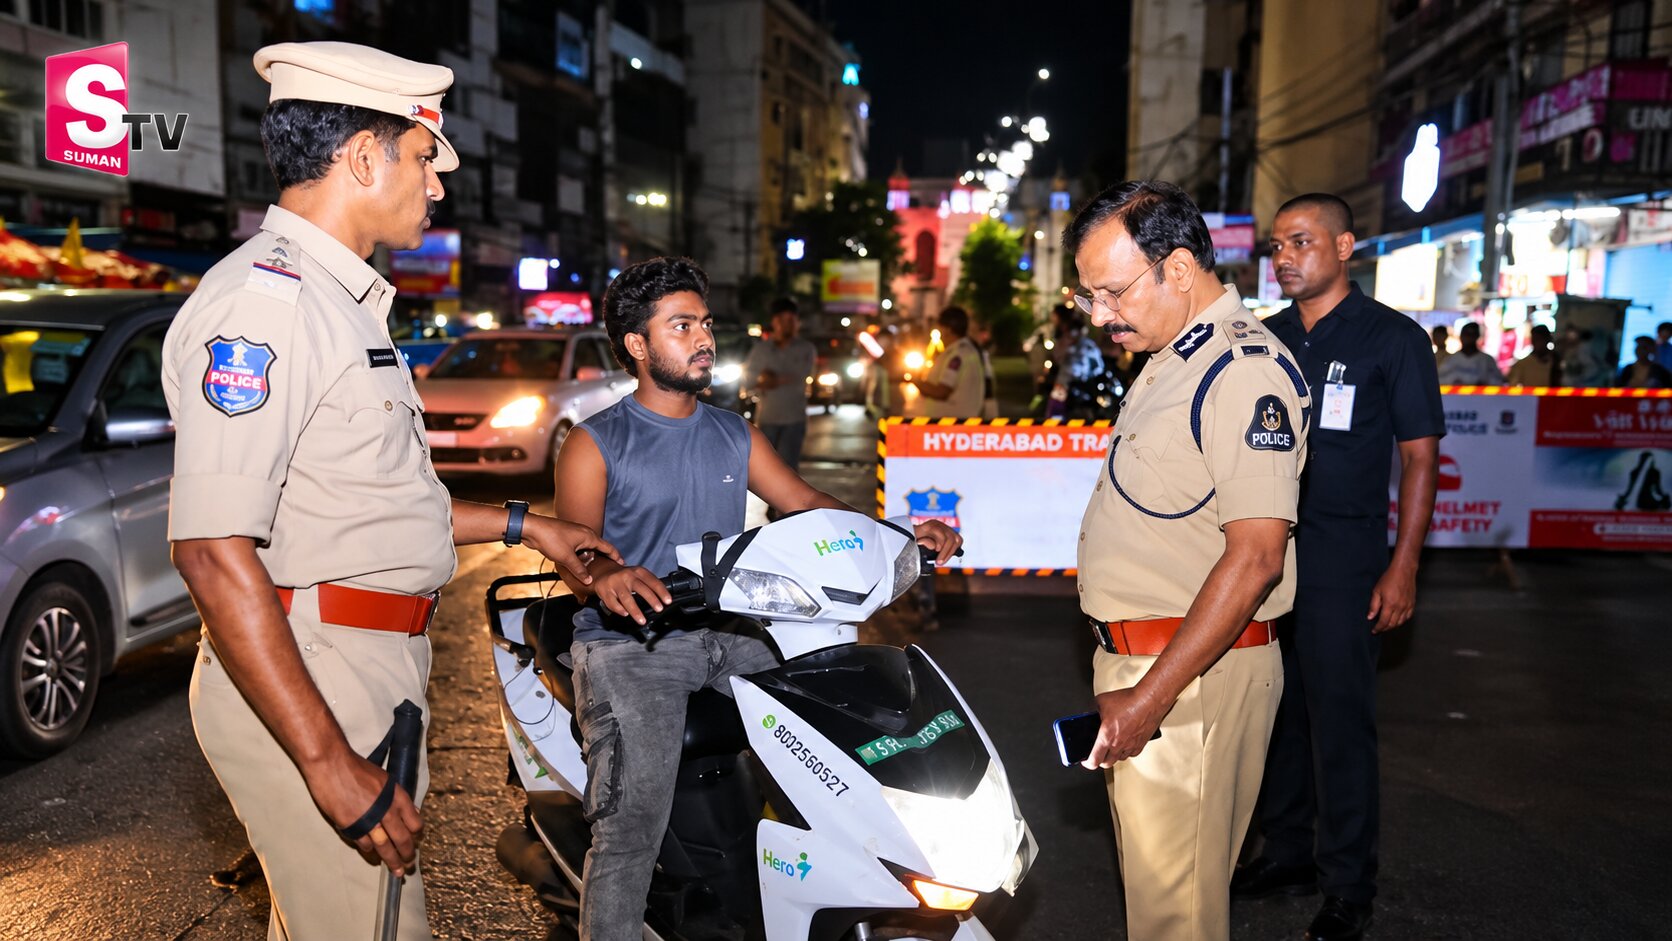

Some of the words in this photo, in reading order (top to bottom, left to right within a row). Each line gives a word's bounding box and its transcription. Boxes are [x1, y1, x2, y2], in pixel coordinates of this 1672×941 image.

[210, 371, 262, 390] POLICE
[923, 432, 1063, 451] HYDERABAD
[1252, 432, 1290, 447] POLICE
[813, 538, 856, 556] Hero
[763, 848, 795, 877] Hero
